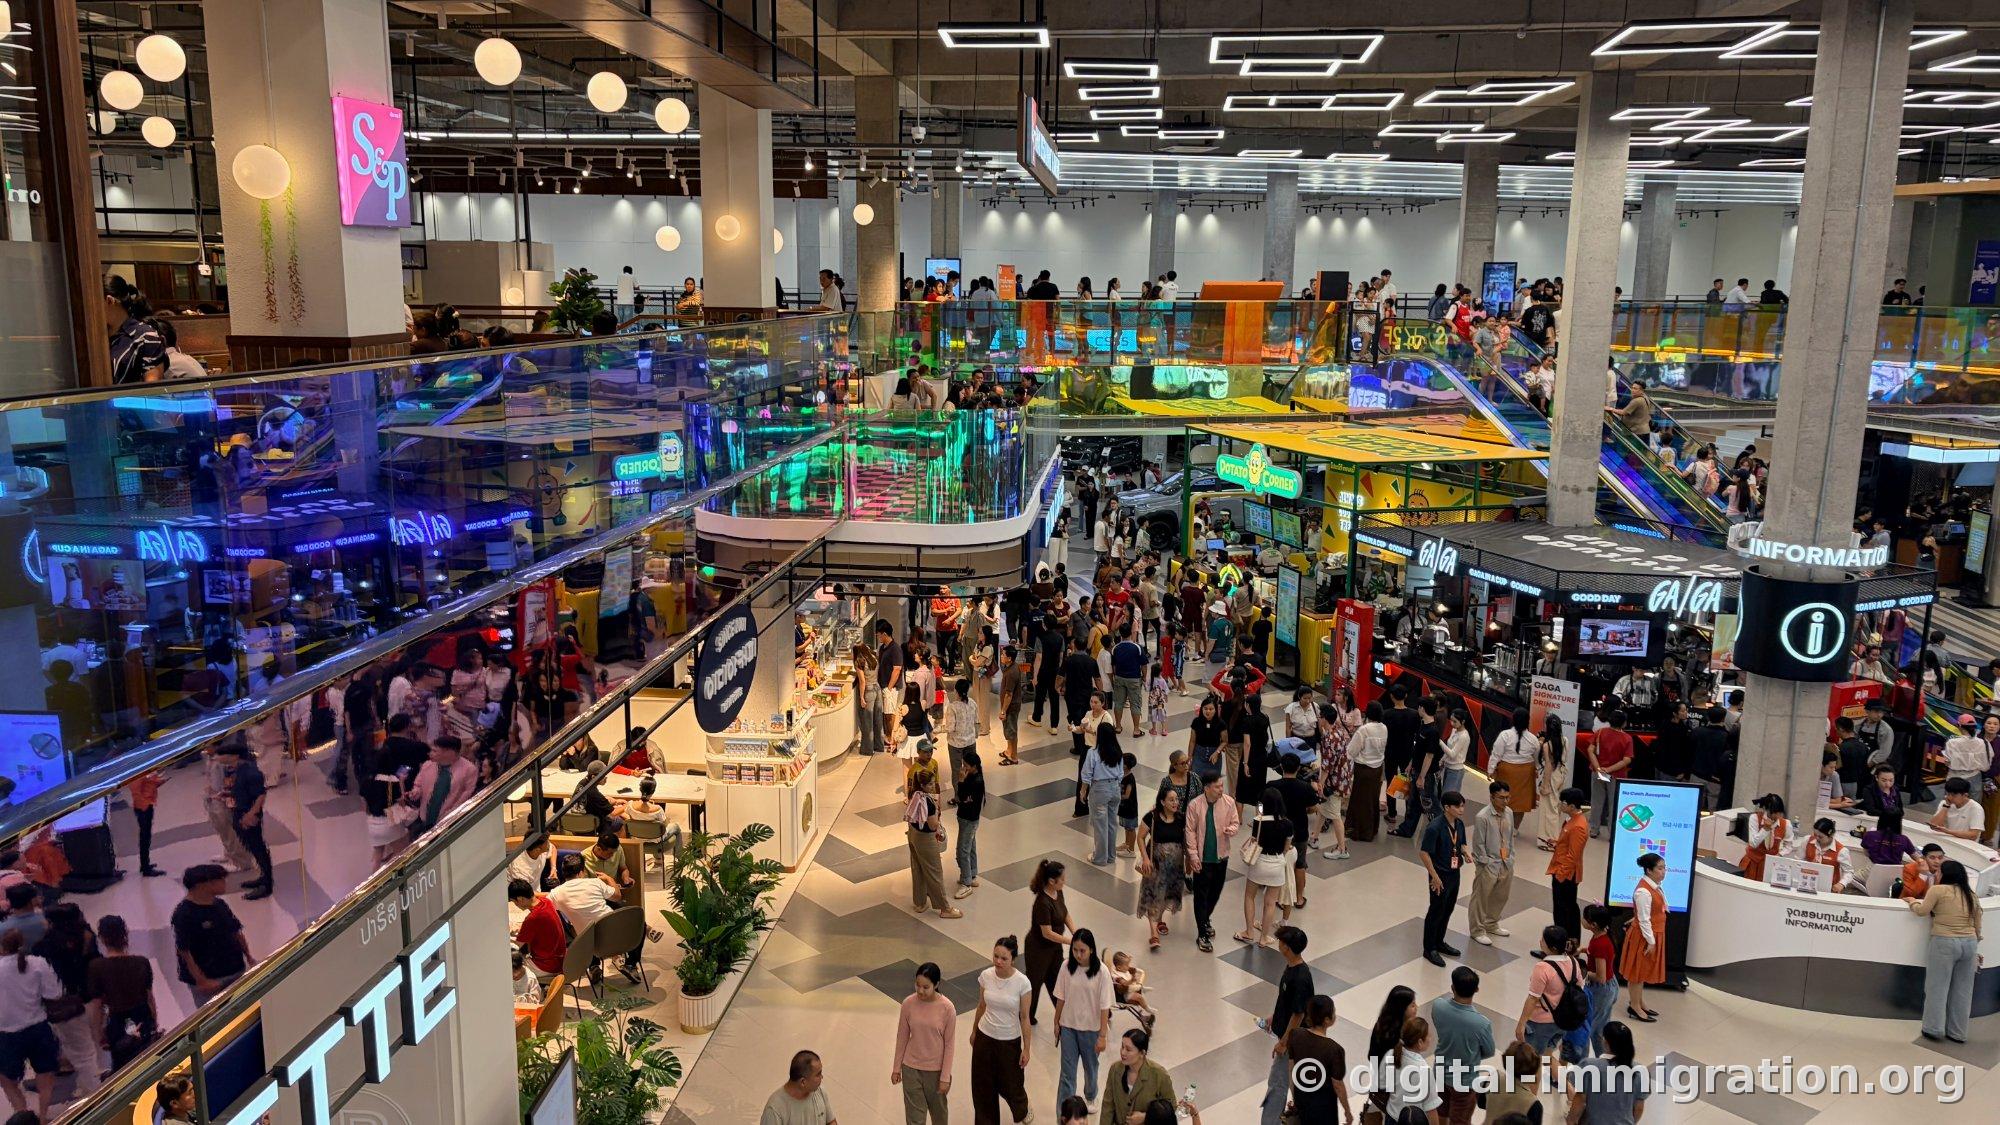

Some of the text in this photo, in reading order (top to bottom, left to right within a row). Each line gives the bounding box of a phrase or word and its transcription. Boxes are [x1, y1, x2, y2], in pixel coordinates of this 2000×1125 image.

[351, 112, 406, 221] S&P
[1220, 459, 1294, 492] POTATO CORNER
[1419, 537, 1459, 571] GA/GA
[1510, 580, 1529, 592] GOOD
[1572, 593, 1622, 603] GOOD DAY
[1650, 575, 1722, 618] GA/GA
[1898, 597, 1920, 606] GOOD
[1534, 681, 1561, 692] GAGA
[1533, 690, 1577, 703] SIGNATURE
[1533, 698, 1561, 709] DRINKS
[1785, 918, 1853, 934] INFORMATION
